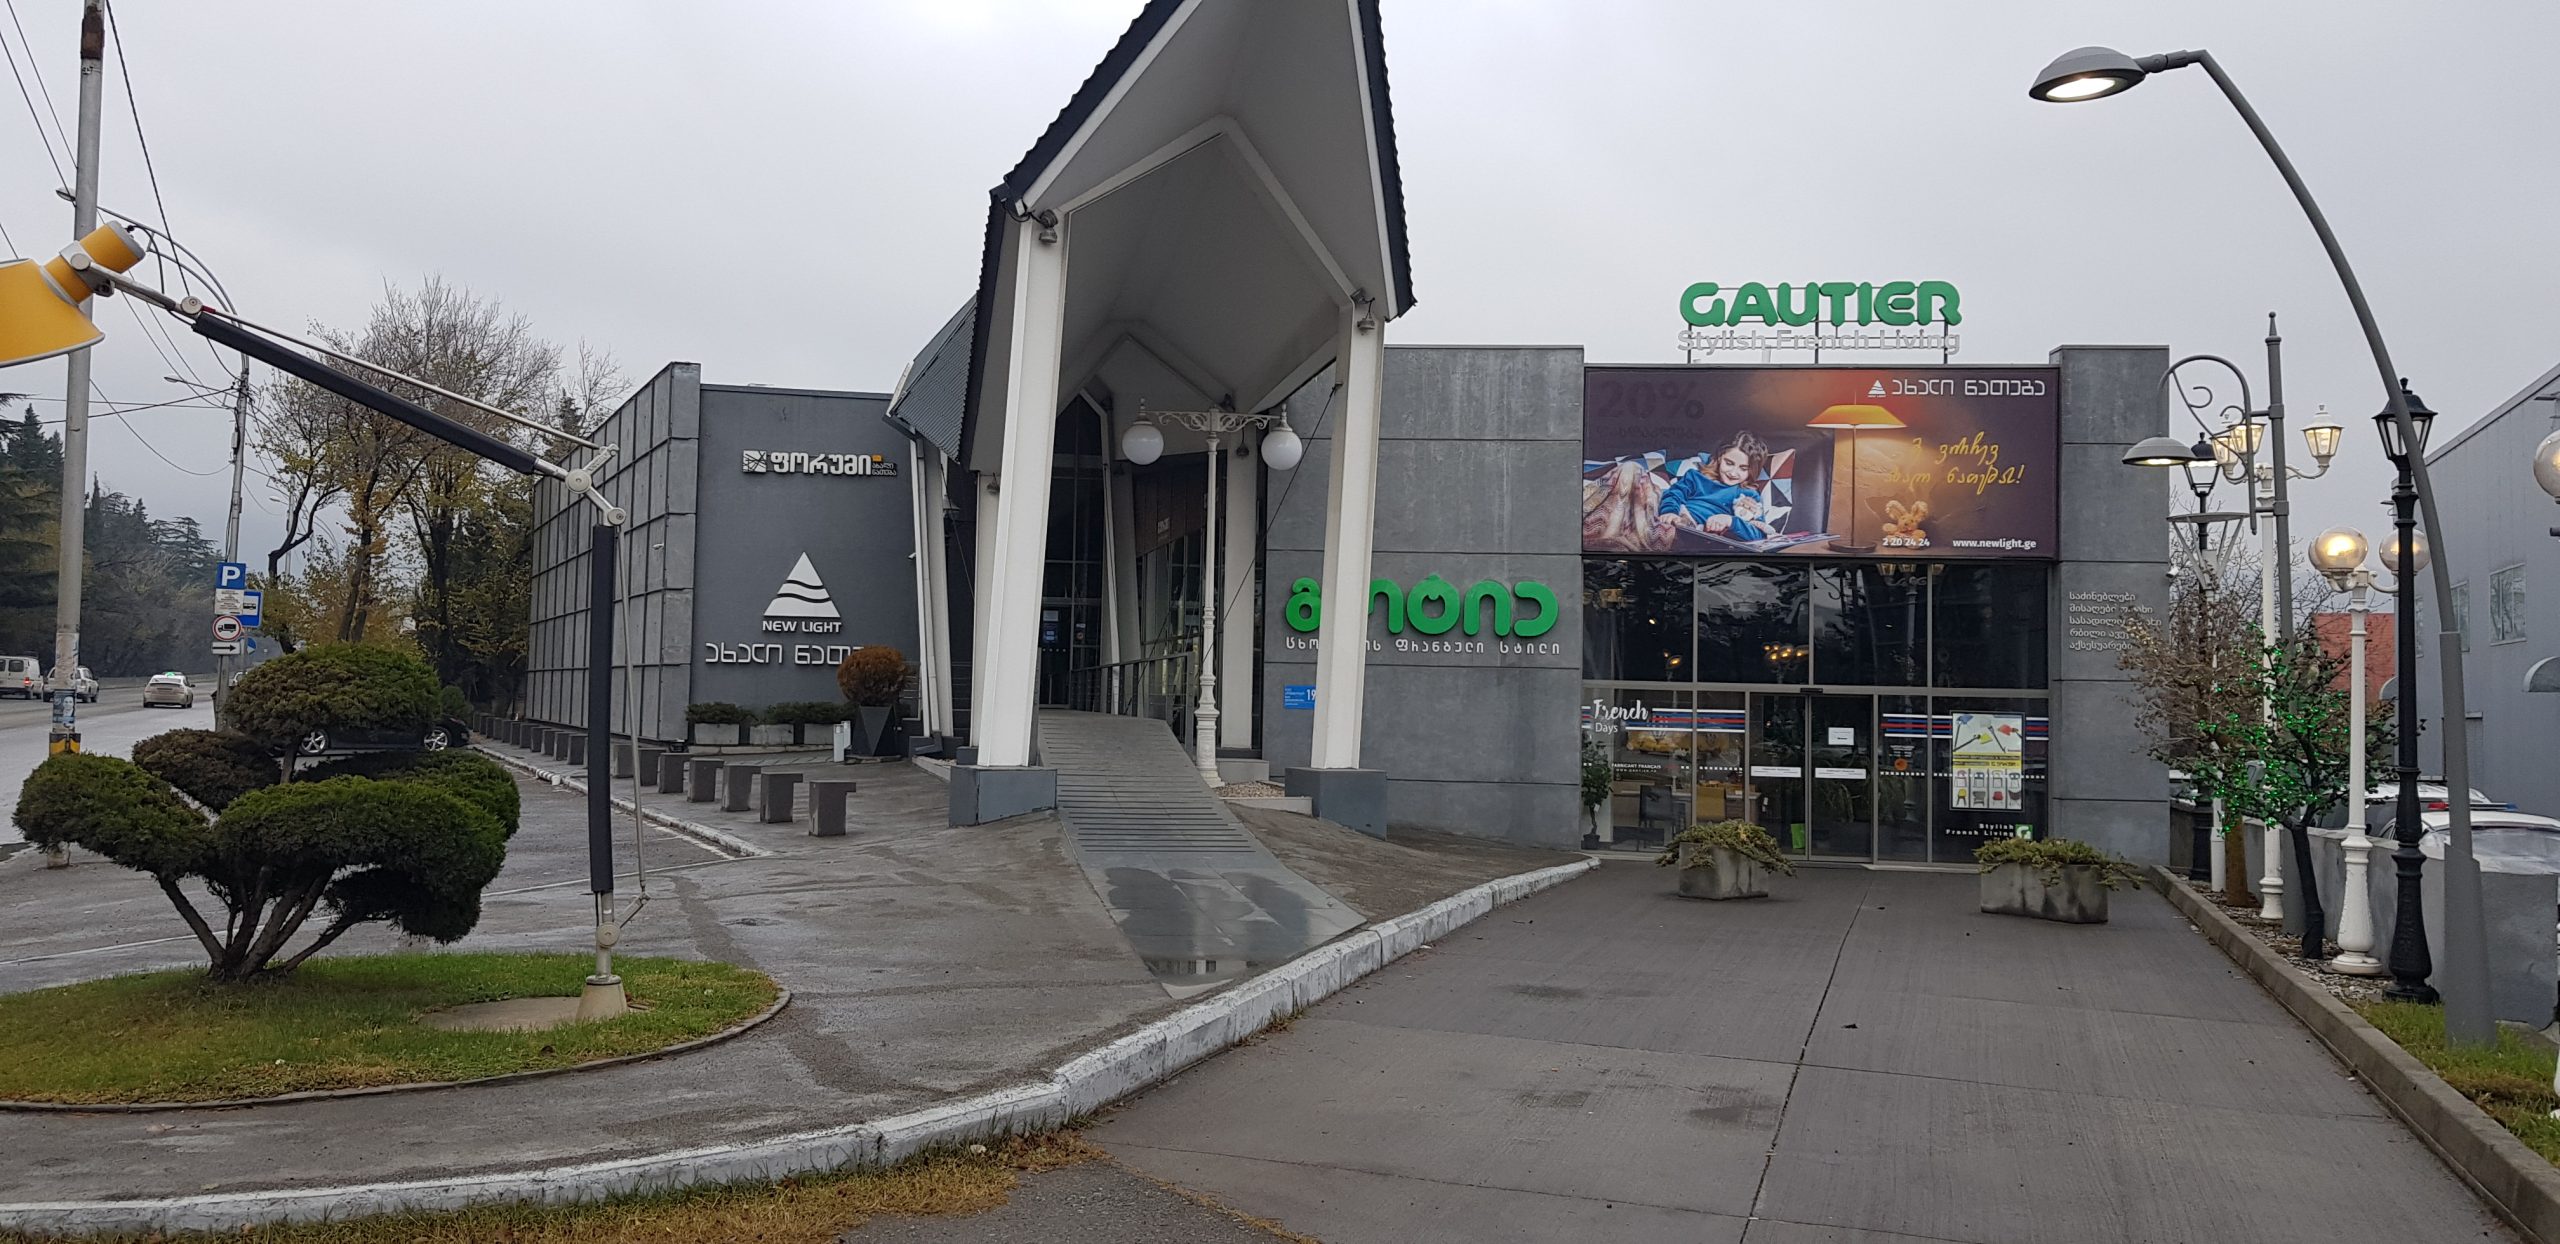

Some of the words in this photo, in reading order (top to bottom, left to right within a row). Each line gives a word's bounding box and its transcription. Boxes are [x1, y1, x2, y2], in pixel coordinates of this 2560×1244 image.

[1680, 281, 1962, 327] GAUTIER
[1677, 330, 1766, 356] Stylish
[1777, 330, 1869, 350] French
[1880, 329, 1961, 355] Living
[770, 451, 872, 476] ფორუმი
[1882, 537, 1889, 547] 2
[1890, 537, 1903, 547] 20
[1905, 537, 1916, 547] 24
[1918, 537, 1930, 548] 24
[1953, 537, 2037, 550] www.newlight.ge
[221, 565, 241, 586] P
[762, 620, 797, 633] NEW
[802, 621, 842, 633] LIGHT
[1593, 699, 1649, 721] French
[1595, 722, 1618, 734] Days
